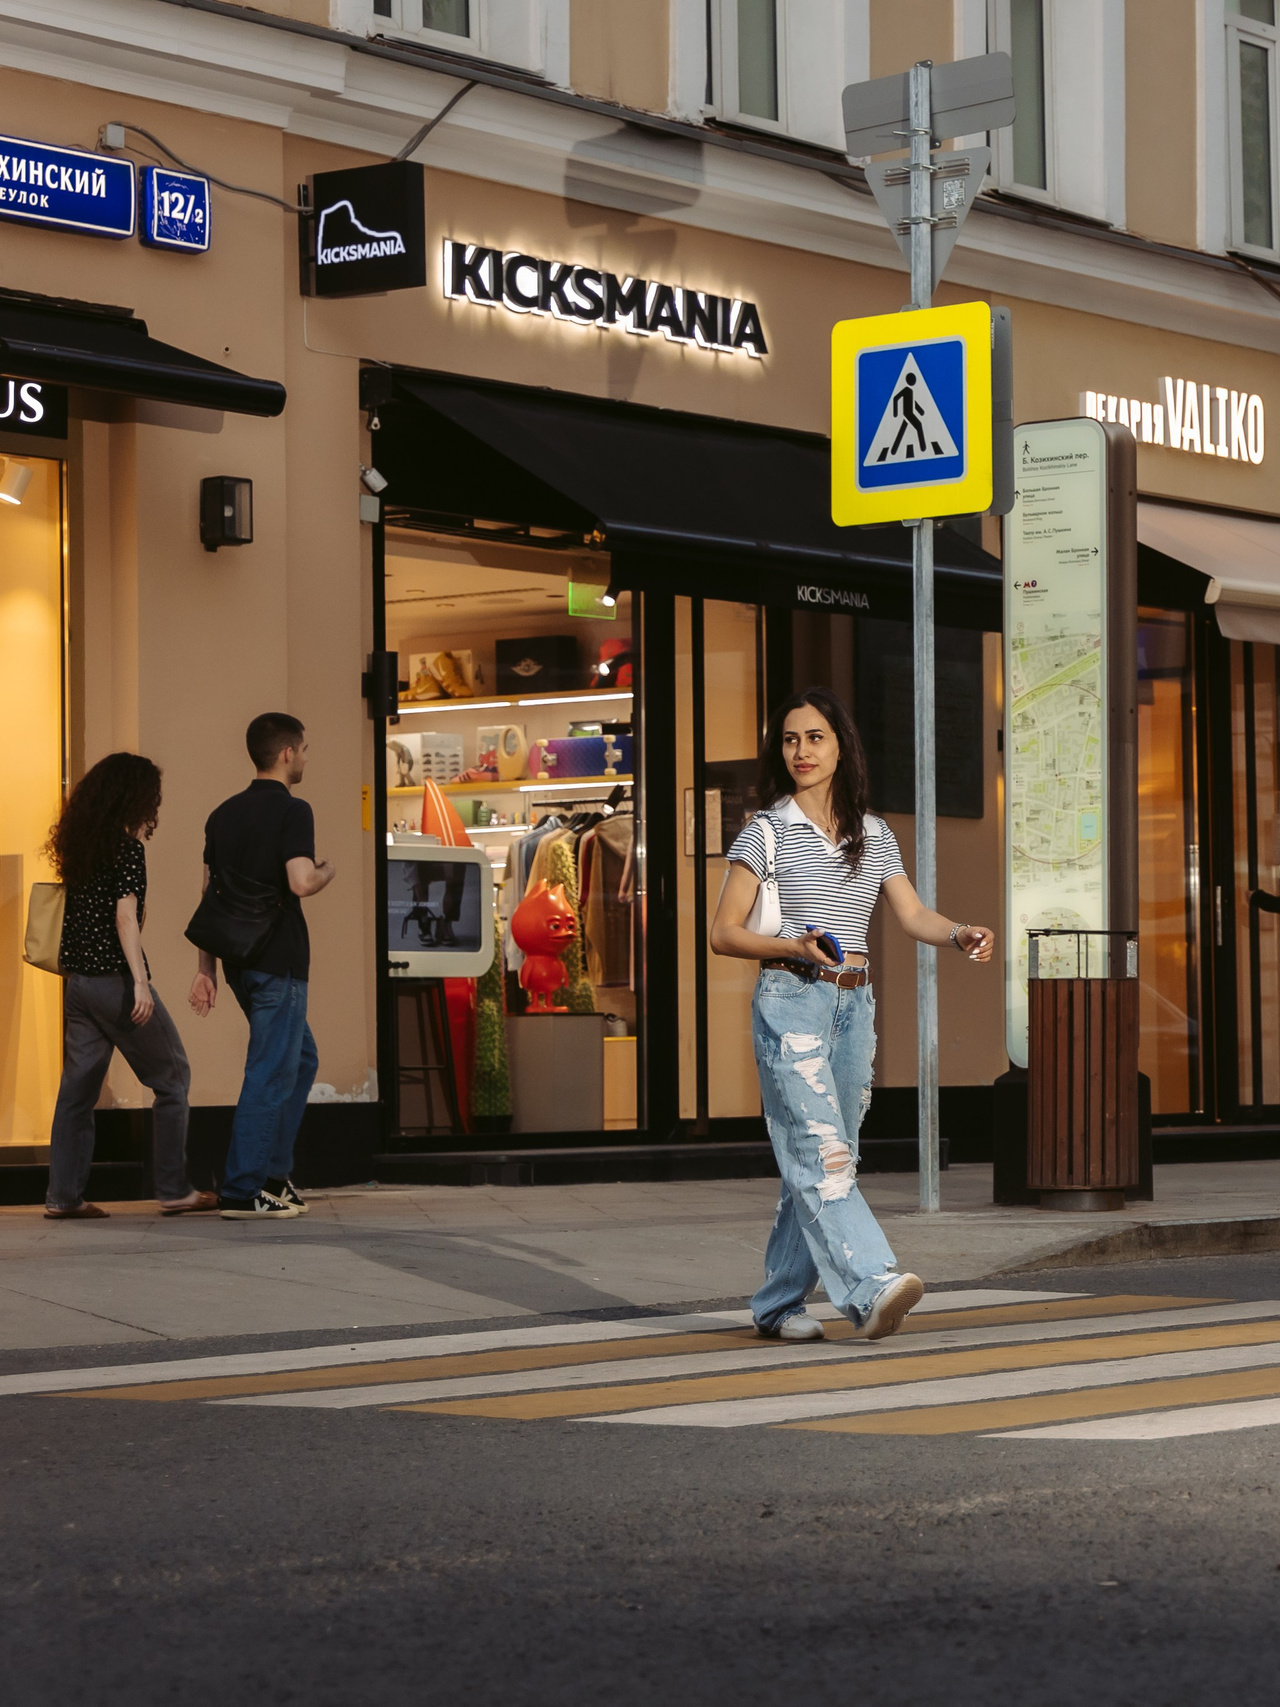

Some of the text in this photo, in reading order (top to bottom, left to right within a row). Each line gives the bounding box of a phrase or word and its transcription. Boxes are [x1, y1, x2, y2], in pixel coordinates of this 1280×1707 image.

[0, 155, 106, 198] ХИНСКИЙ
[0, 187, 49, 208] ЕУЛОК
[160, 191, 204, 224] 12/2
[318, 239, 406, 265] KICKSMANIA
[445, 239, 769, 356] KICKSMANIA
[1162, 376, 1265, 465] VALIKO
[1022, 457, 1029, 465] Б.
[1030, 453, 1073, 464] Козихинский
[797, 585, 870, 609] KICKSMANIA
